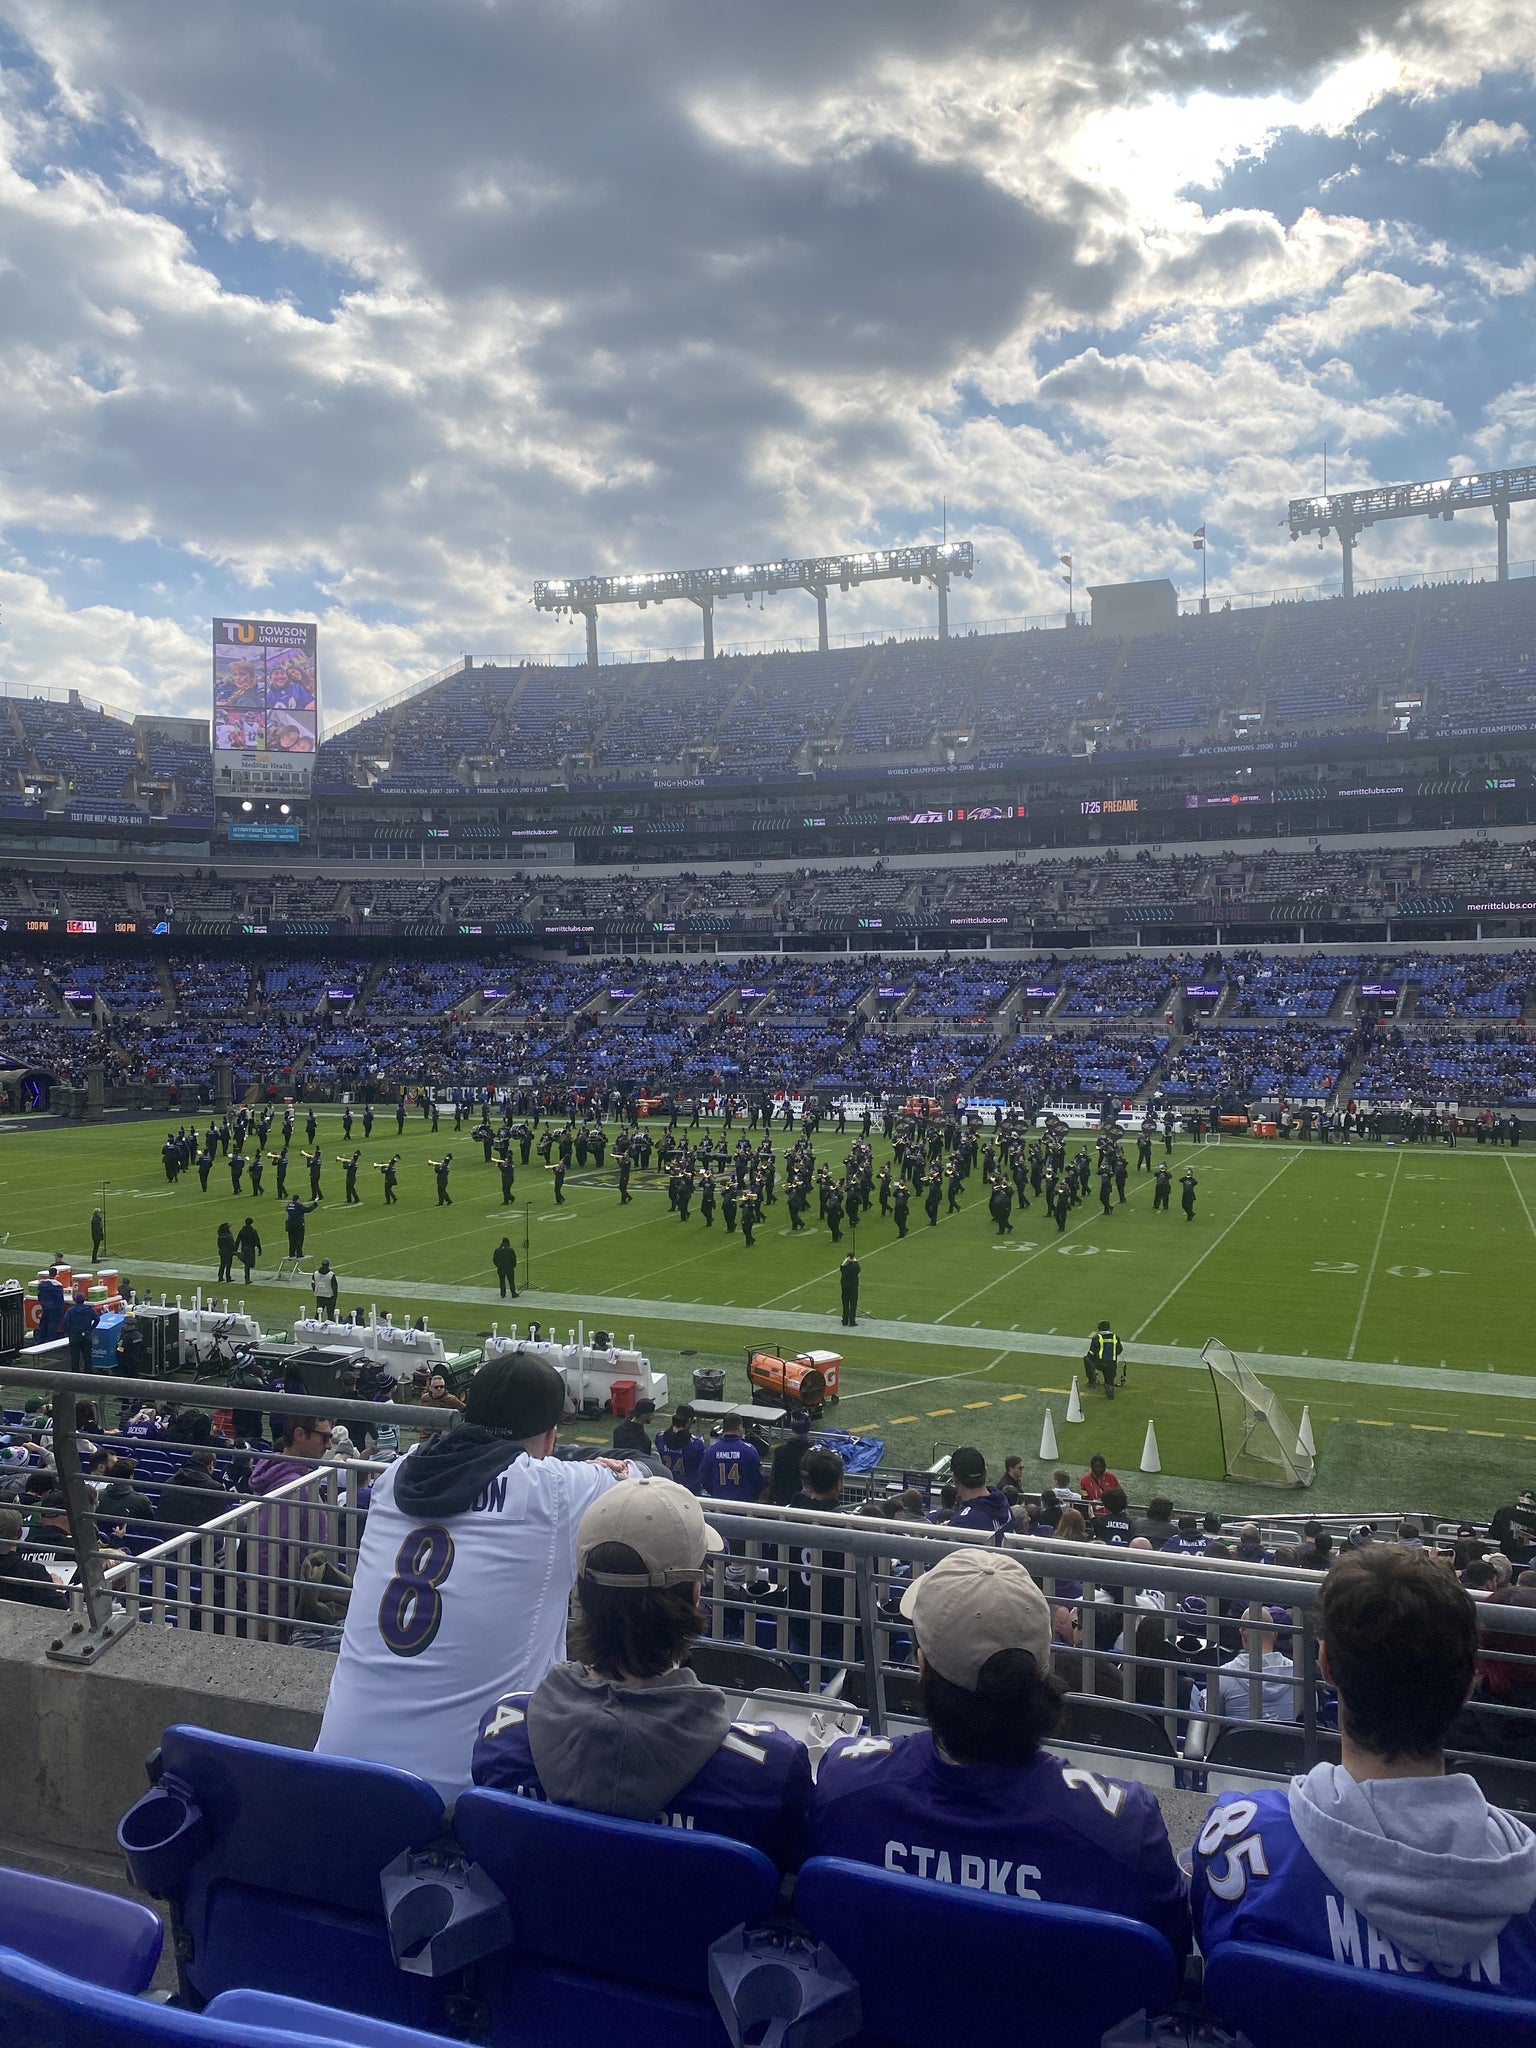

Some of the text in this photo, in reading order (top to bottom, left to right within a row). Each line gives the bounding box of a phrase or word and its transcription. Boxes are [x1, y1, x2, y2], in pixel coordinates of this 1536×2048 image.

[222, 622, 254, 643] TU
[259, 626, 307, 636] TOWSON
[259, 635, 307, 645] UNIVERSITY
[1451, 728, 1478, 736] NORTH
[1480, 724, 1528, 734] CHAMPIONS
[1213, 744, 1255, 754] CHAMPIONS
[1280, 741, 1298, 749] 2012
[910, 766, 945, 774] CHAMPIONS
[677, 779, 705, 787] HONOR
[1338, 786, 1404, 796] merrittclubs.com
[1008, 806, 1014, 818] 0
[1081, 799, 1138, 814] 17:25 PREGAME
[71, 813, 83, 821] TEXT
[94, 814, 107, 822] HELP
[910, 811, 944, 824] JETS
[948, 809, 954, 821] 0
[27, 921, 48, 930] 1:00 PM
[950, 916, 1008, 924] merrittclubs.com
[114, 923, 136, 932] 1:00 PM
[823, 1366, 837, 1388] G
[715, 1451, 741, 1460] HAMILTON
[718, 1462, 741, 1487] 14
[1106, 1520, 1130, 1531] JACKSON
[1179, 1539, 1207, 1547] ANDREWS
[378, 1525, 456, 1658] 8
[483, 1704, 526, 1739] 4
[1062, 1767, 1127, 1817] 2
[1198, 1799, 1270, 1901] 85
